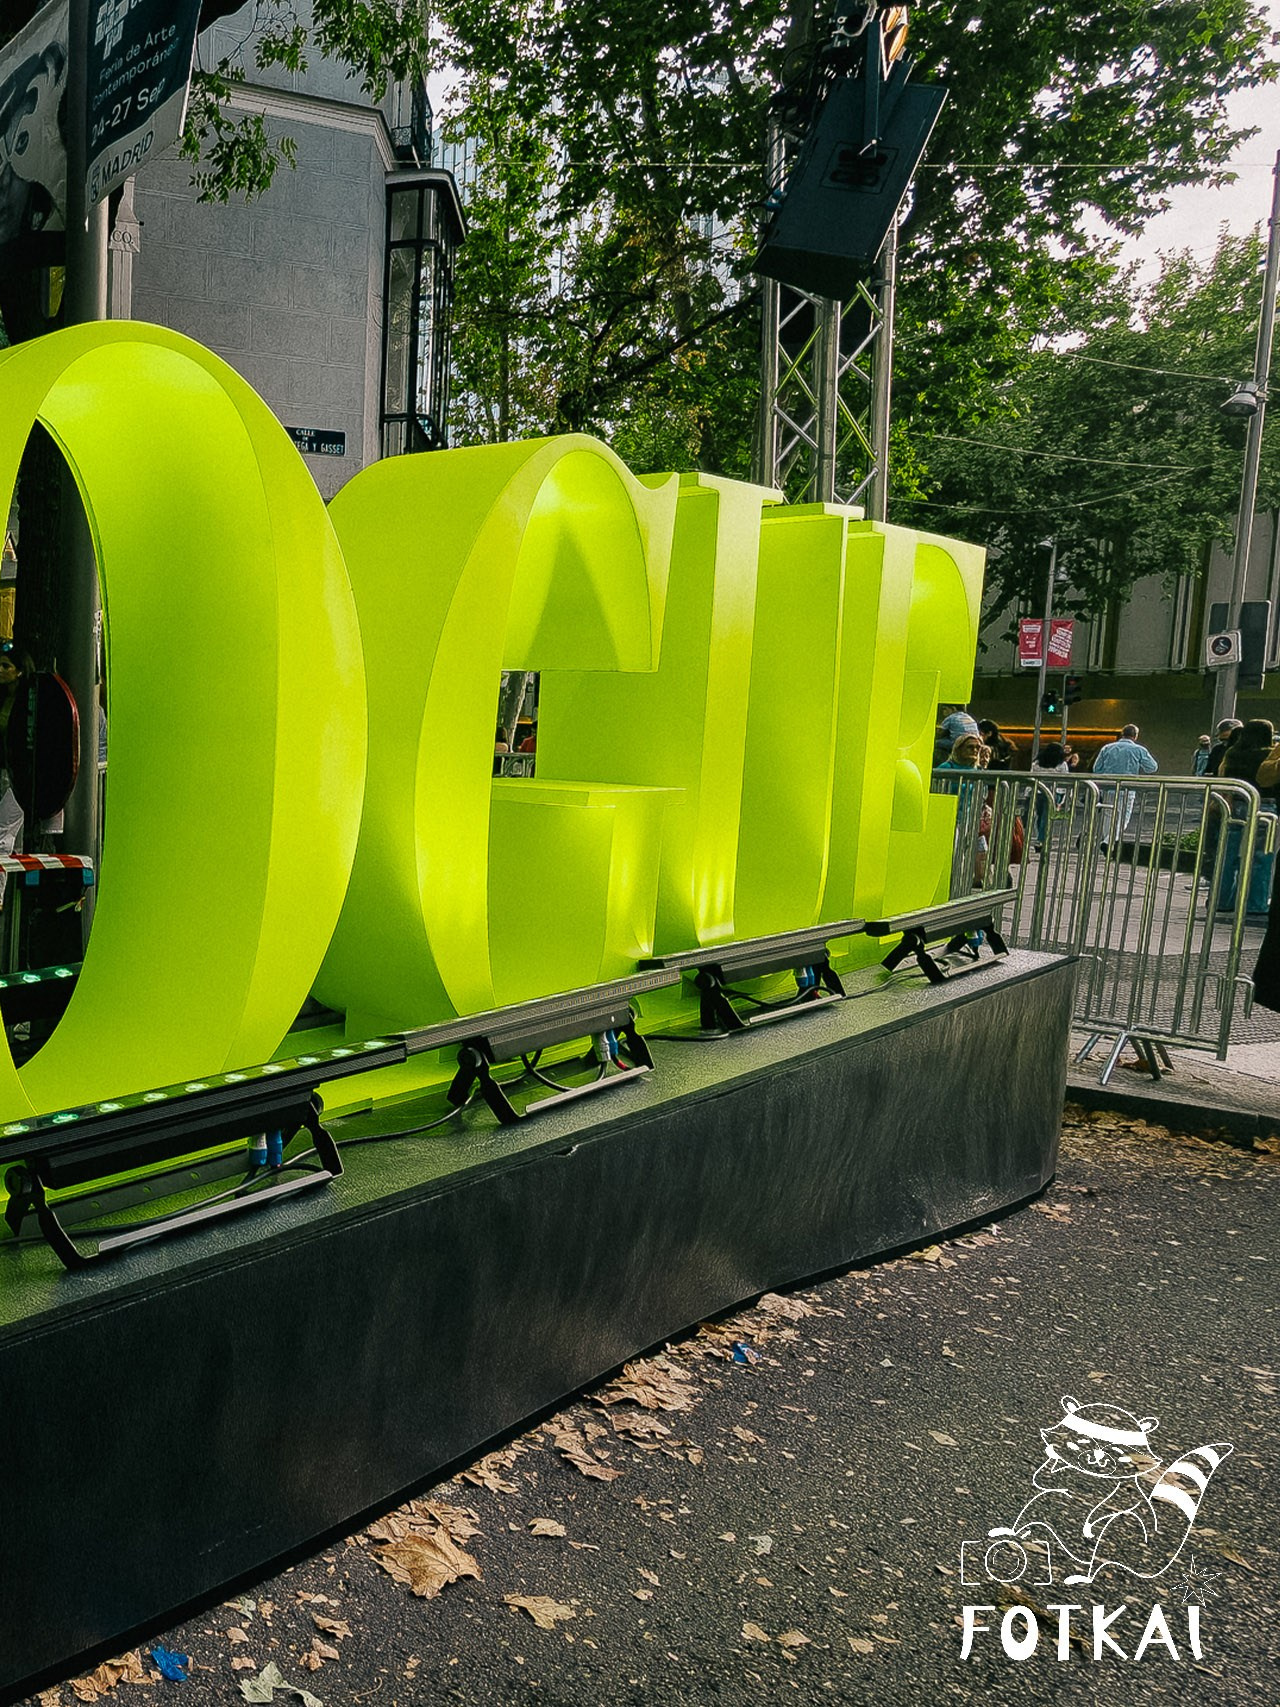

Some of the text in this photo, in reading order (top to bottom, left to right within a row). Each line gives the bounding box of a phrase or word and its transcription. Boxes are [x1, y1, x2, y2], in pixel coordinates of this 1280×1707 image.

[125, 44, 140, 62] de
[144, 24, 176, 50] Arte
[91, 77, 166, 147] 24-27 Sep
[102, 130, 154, 187] MADRID
[312, 443, 317, 452] Y
[321, 443, 344, 454] GASSET
